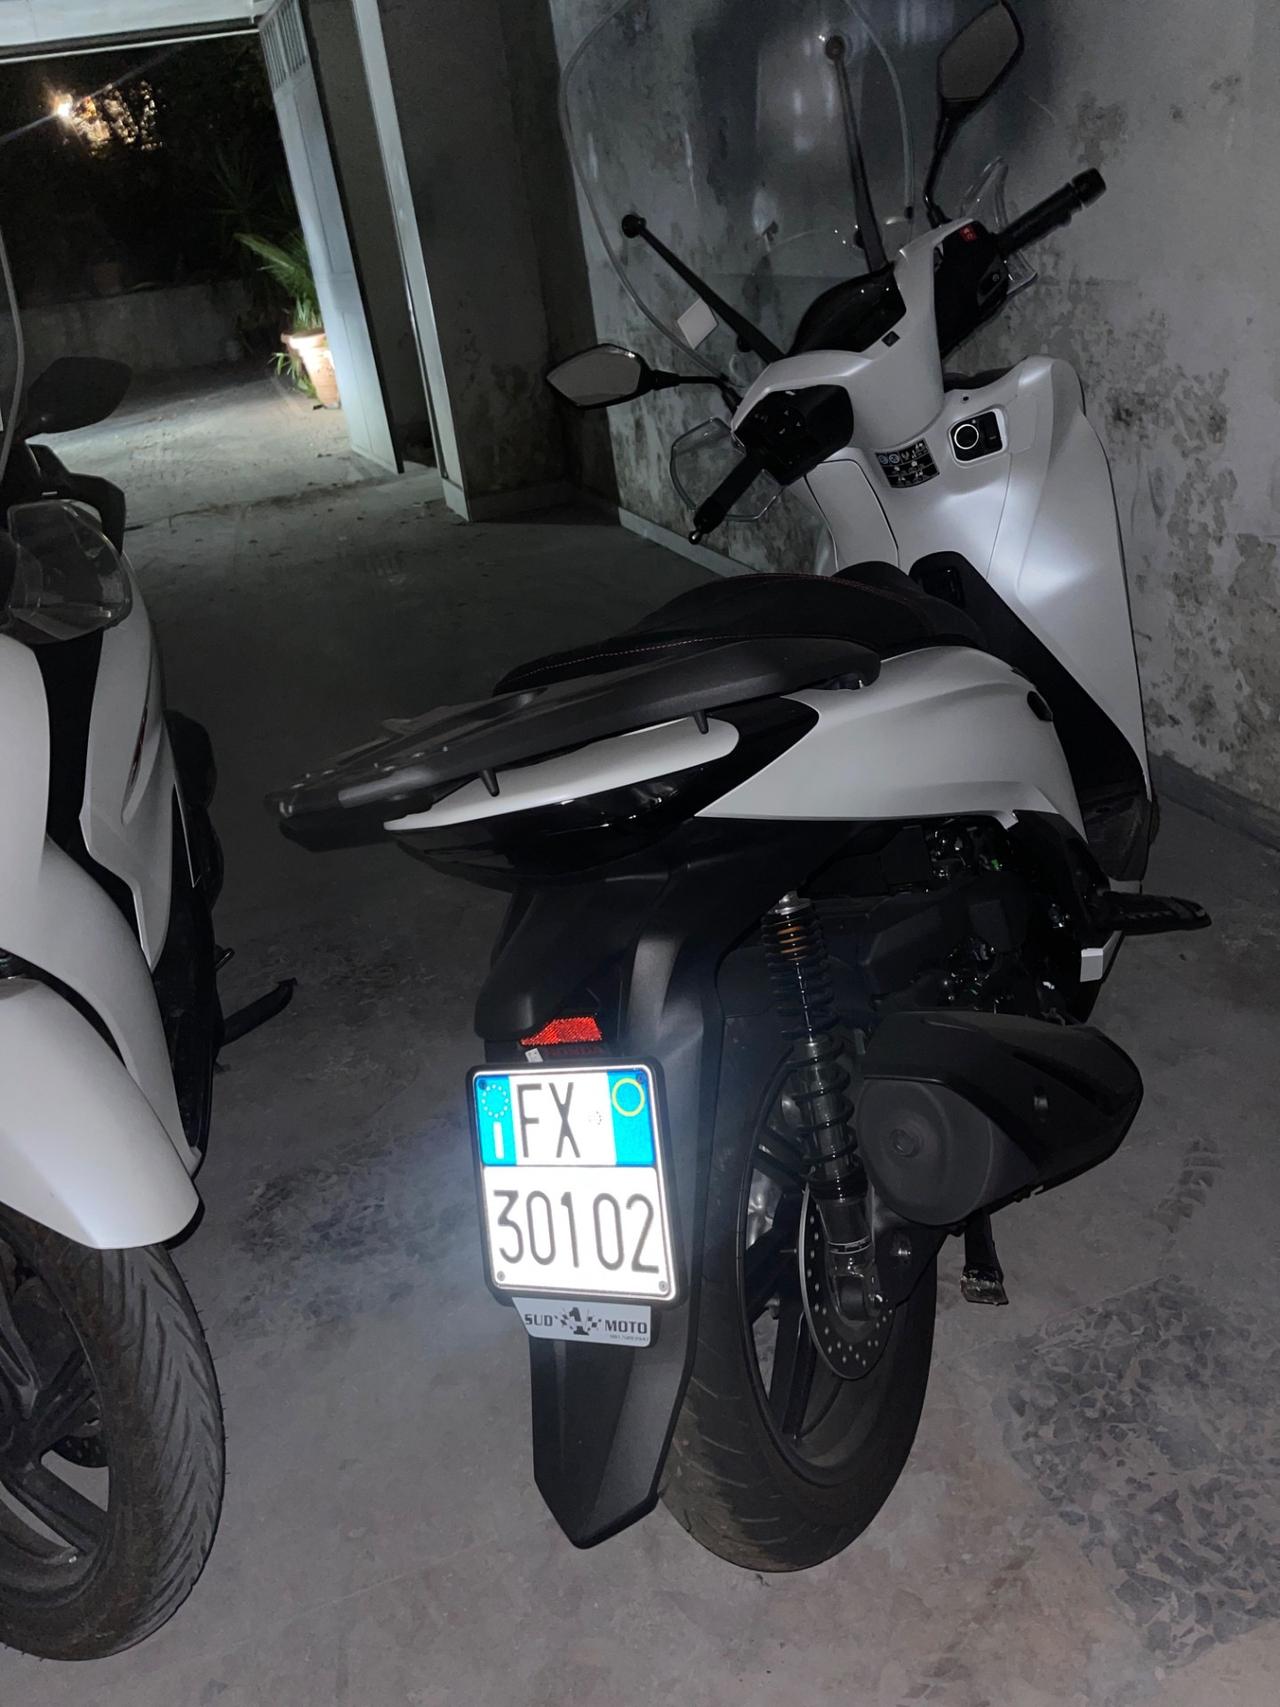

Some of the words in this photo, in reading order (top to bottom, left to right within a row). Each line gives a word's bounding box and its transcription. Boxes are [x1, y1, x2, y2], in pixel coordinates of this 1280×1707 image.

[516, 1081, 581, 1158] FX
[493, 1189, 660, 1274] 30102
[525, 1314, 552, 1327] SUD
[604, 1319, 648, 1334] MOTO
